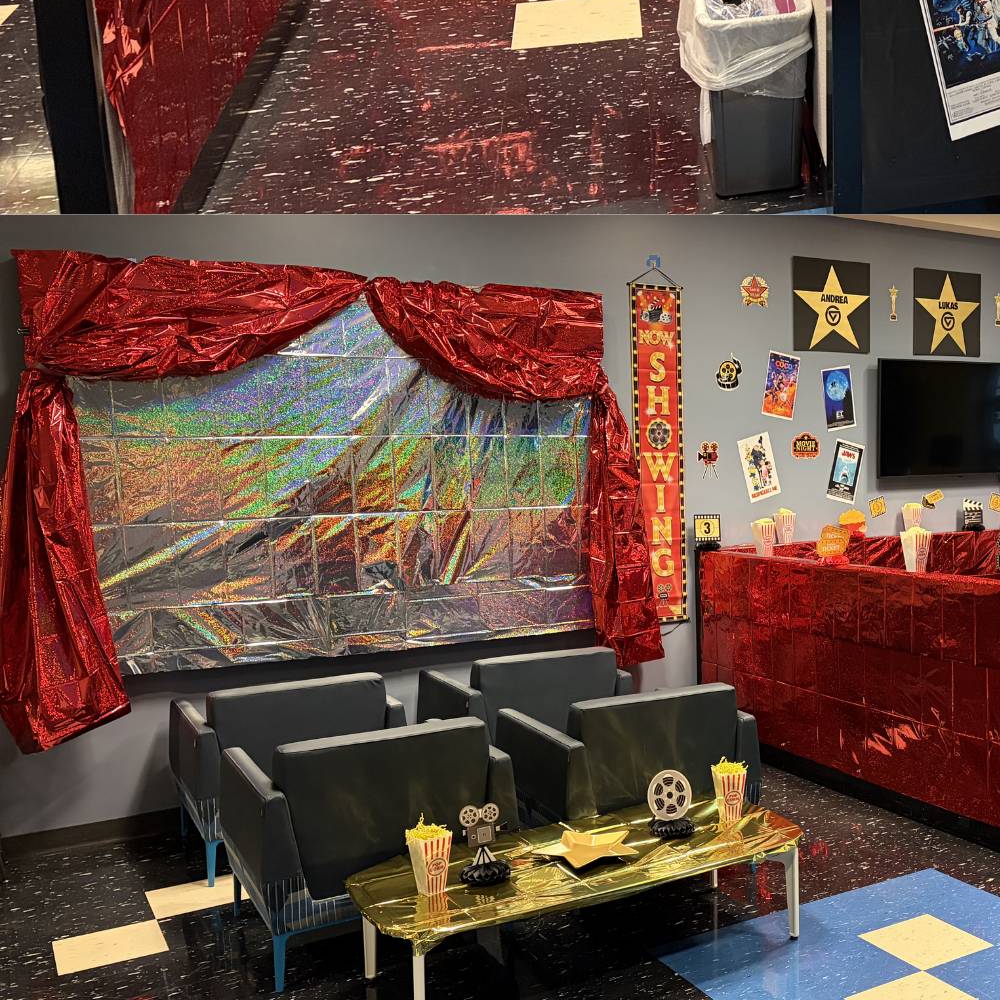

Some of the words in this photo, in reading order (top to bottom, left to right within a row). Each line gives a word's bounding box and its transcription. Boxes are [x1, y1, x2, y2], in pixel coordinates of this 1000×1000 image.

[821, 293, 849, 304] ANDREA
[939, 301, 959, 311] LUKAS
[639, 329, 677, 347] NOW
[704, 521, 711, 535] 3
